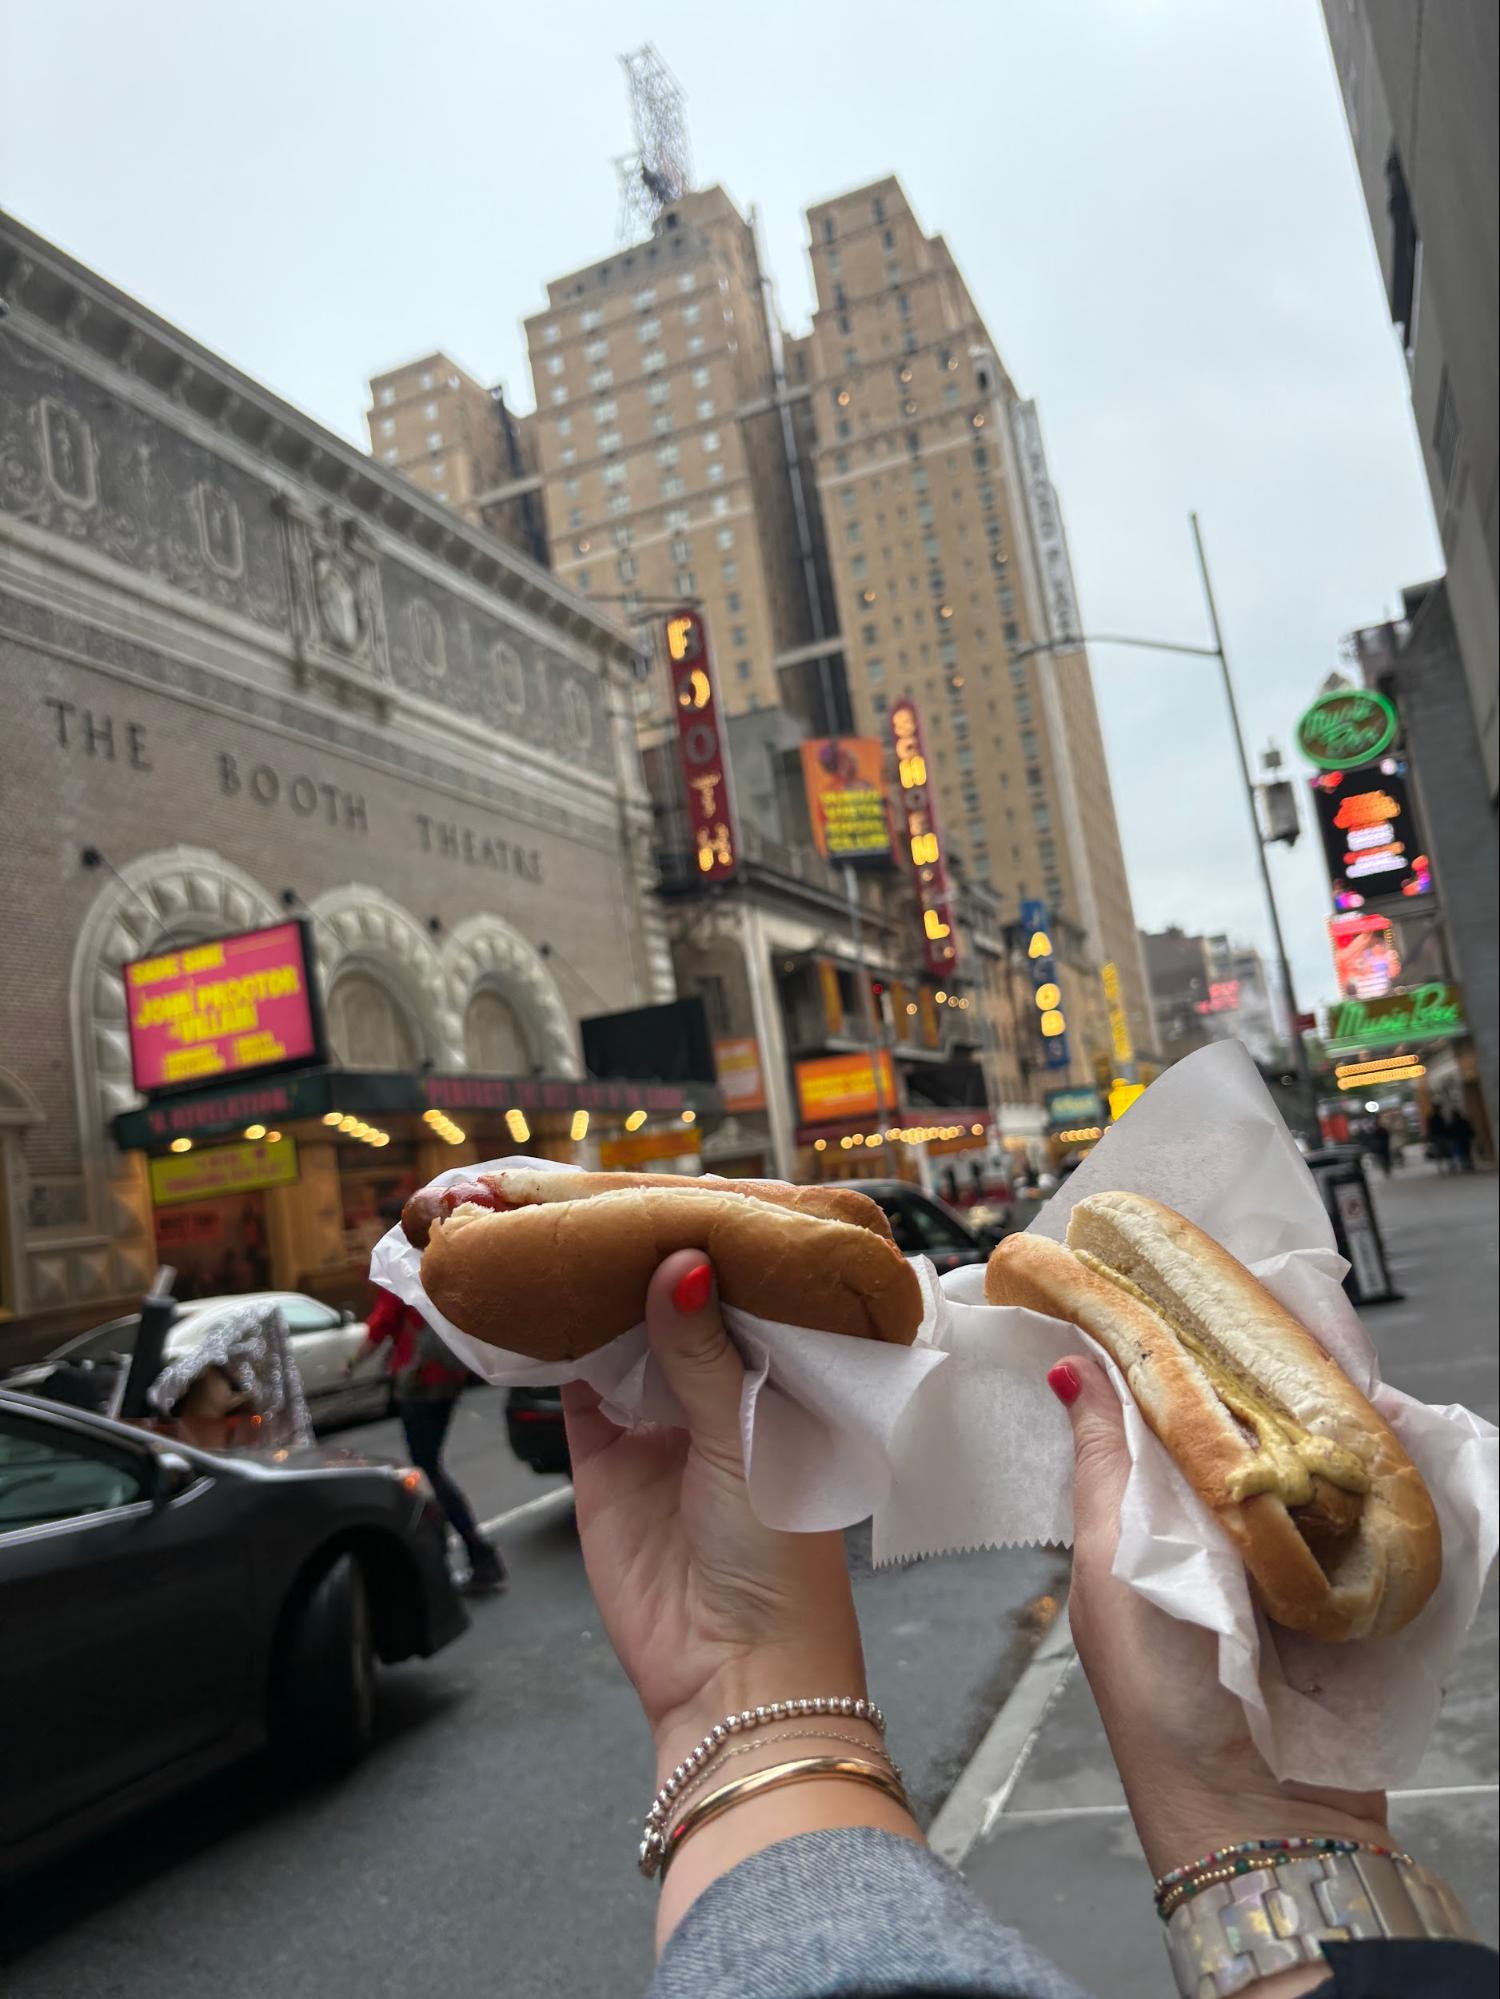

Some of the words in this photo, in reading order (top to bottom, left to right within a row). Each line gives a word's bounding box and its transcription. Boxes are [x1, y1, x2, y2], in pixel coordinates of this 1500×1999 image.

[44, 696, 153, 772] THE
[218, 751, 370, 835] BOOTH
[1336, 1001, 1409, 1036] Music
